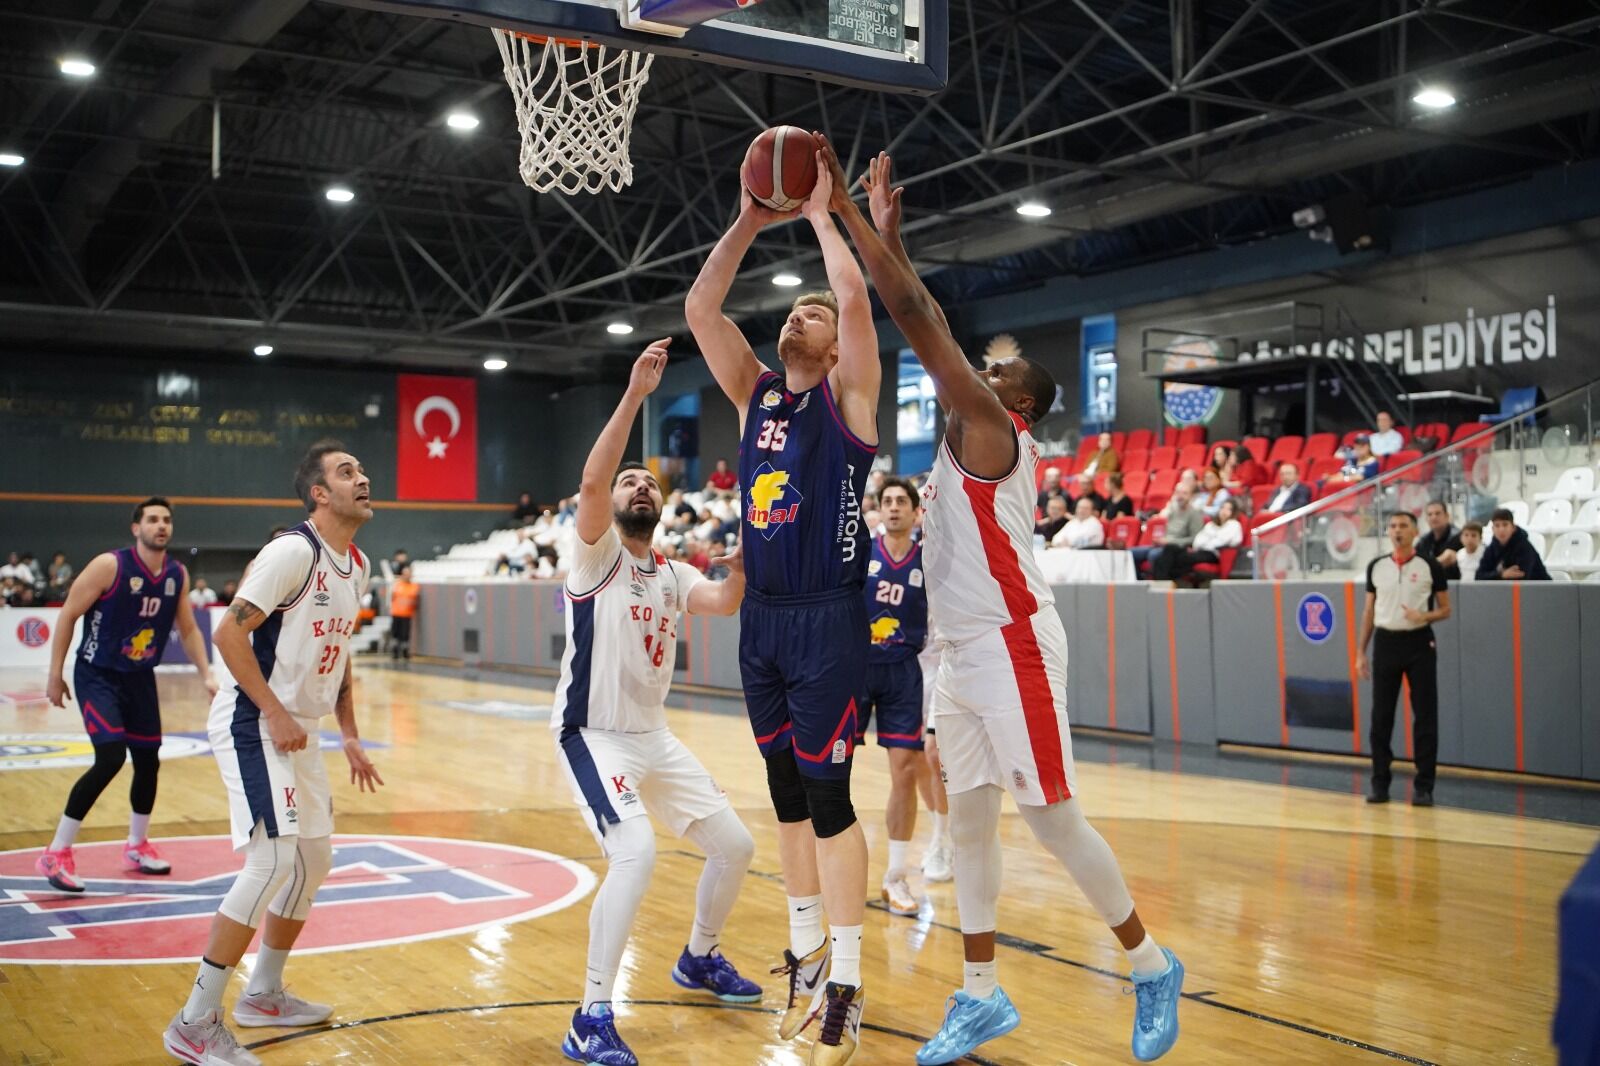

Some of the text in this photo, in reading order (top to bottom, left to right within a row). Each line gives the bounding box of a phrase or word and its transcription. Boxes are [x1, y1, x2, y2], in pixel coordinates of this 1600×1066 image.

[757, 419, 789, 451] 35
[316, 571, 329, 592] K
[876, 580, 904, 606] 20
[139, 597, 161, 617] 10
[318, 645, 341, 675] 23
[611, 775, 631, 794] K
[284, 787, 296, 808] K
